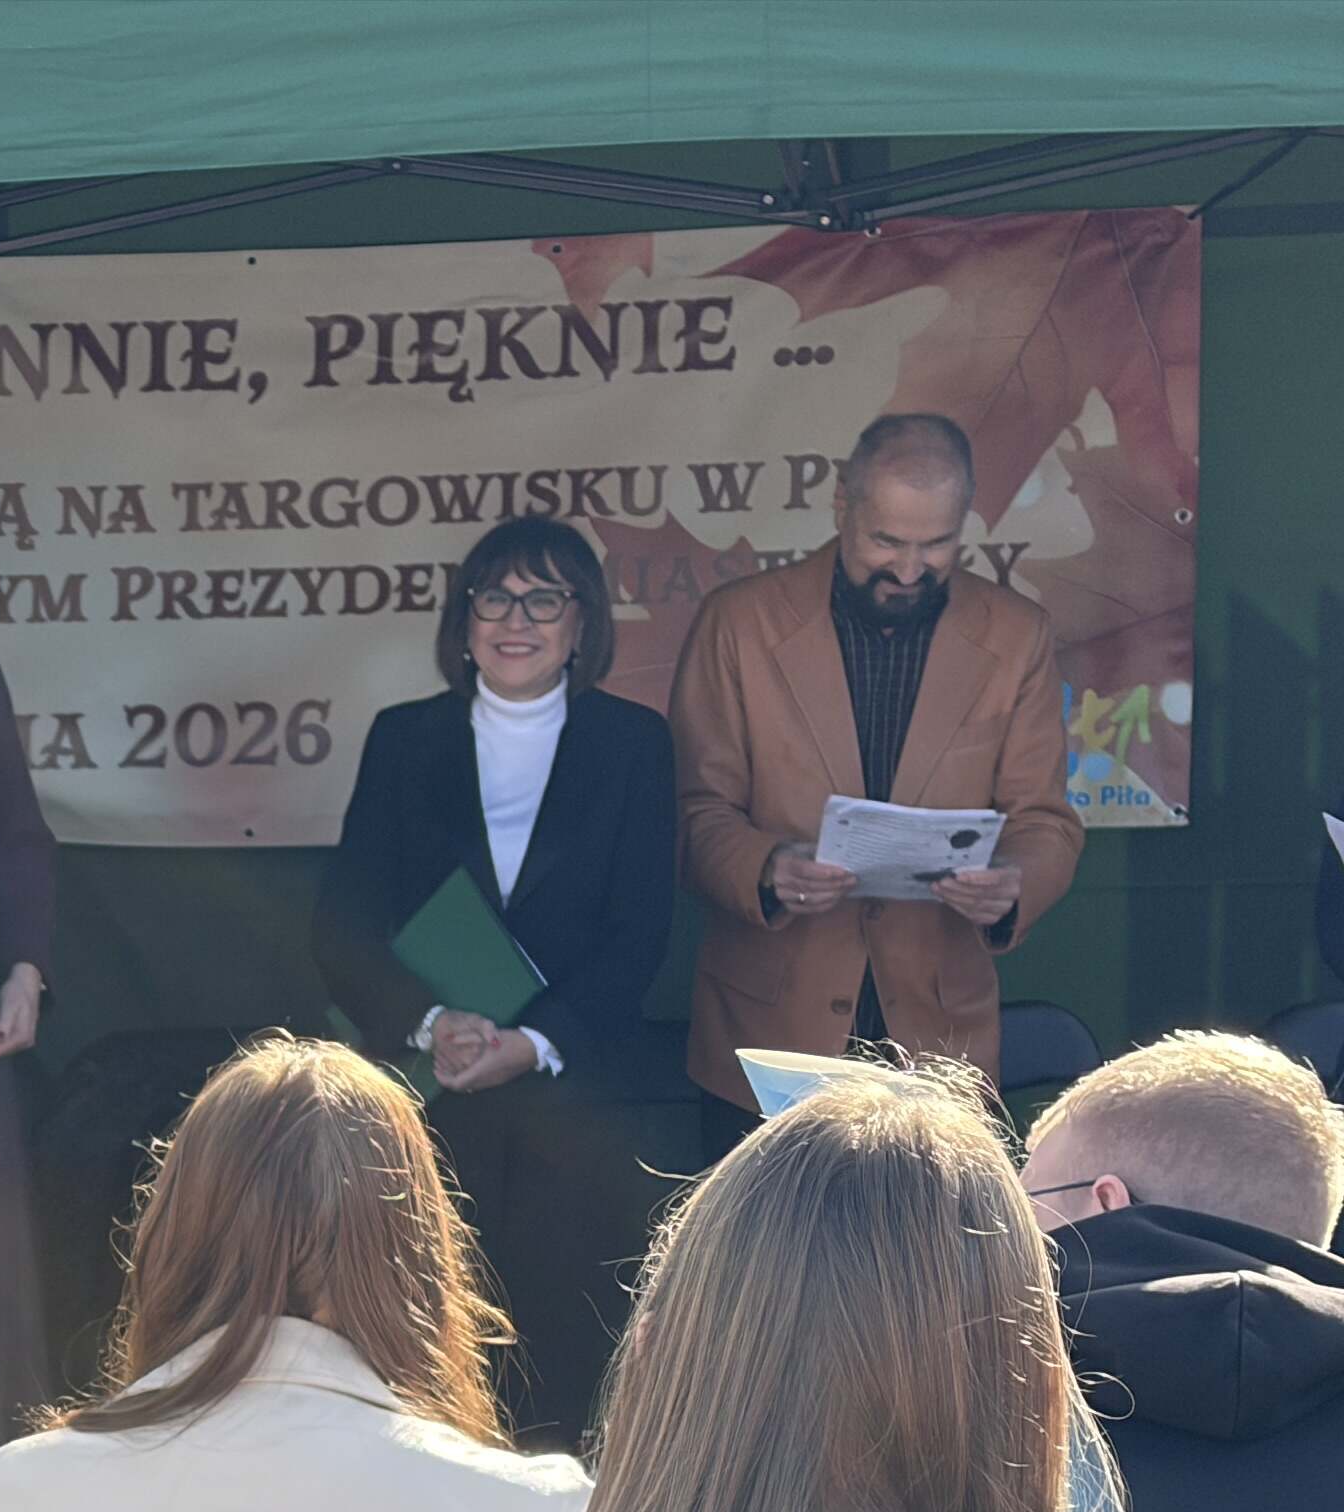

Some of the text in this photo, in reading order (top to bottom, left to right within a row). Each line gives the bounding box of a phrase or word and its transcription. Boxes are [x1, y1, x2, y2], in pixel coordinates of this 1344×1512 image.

[303, 296, 737, 403] PIĘKNIE
[56, 484, 158, 538] NA
[172, 465, 669, 532] TARGOWISKU
[687, 460, 766, 513] W
[111, 562, 464, 622] PREZYDE
[117, 698, 333, 769] 2026
